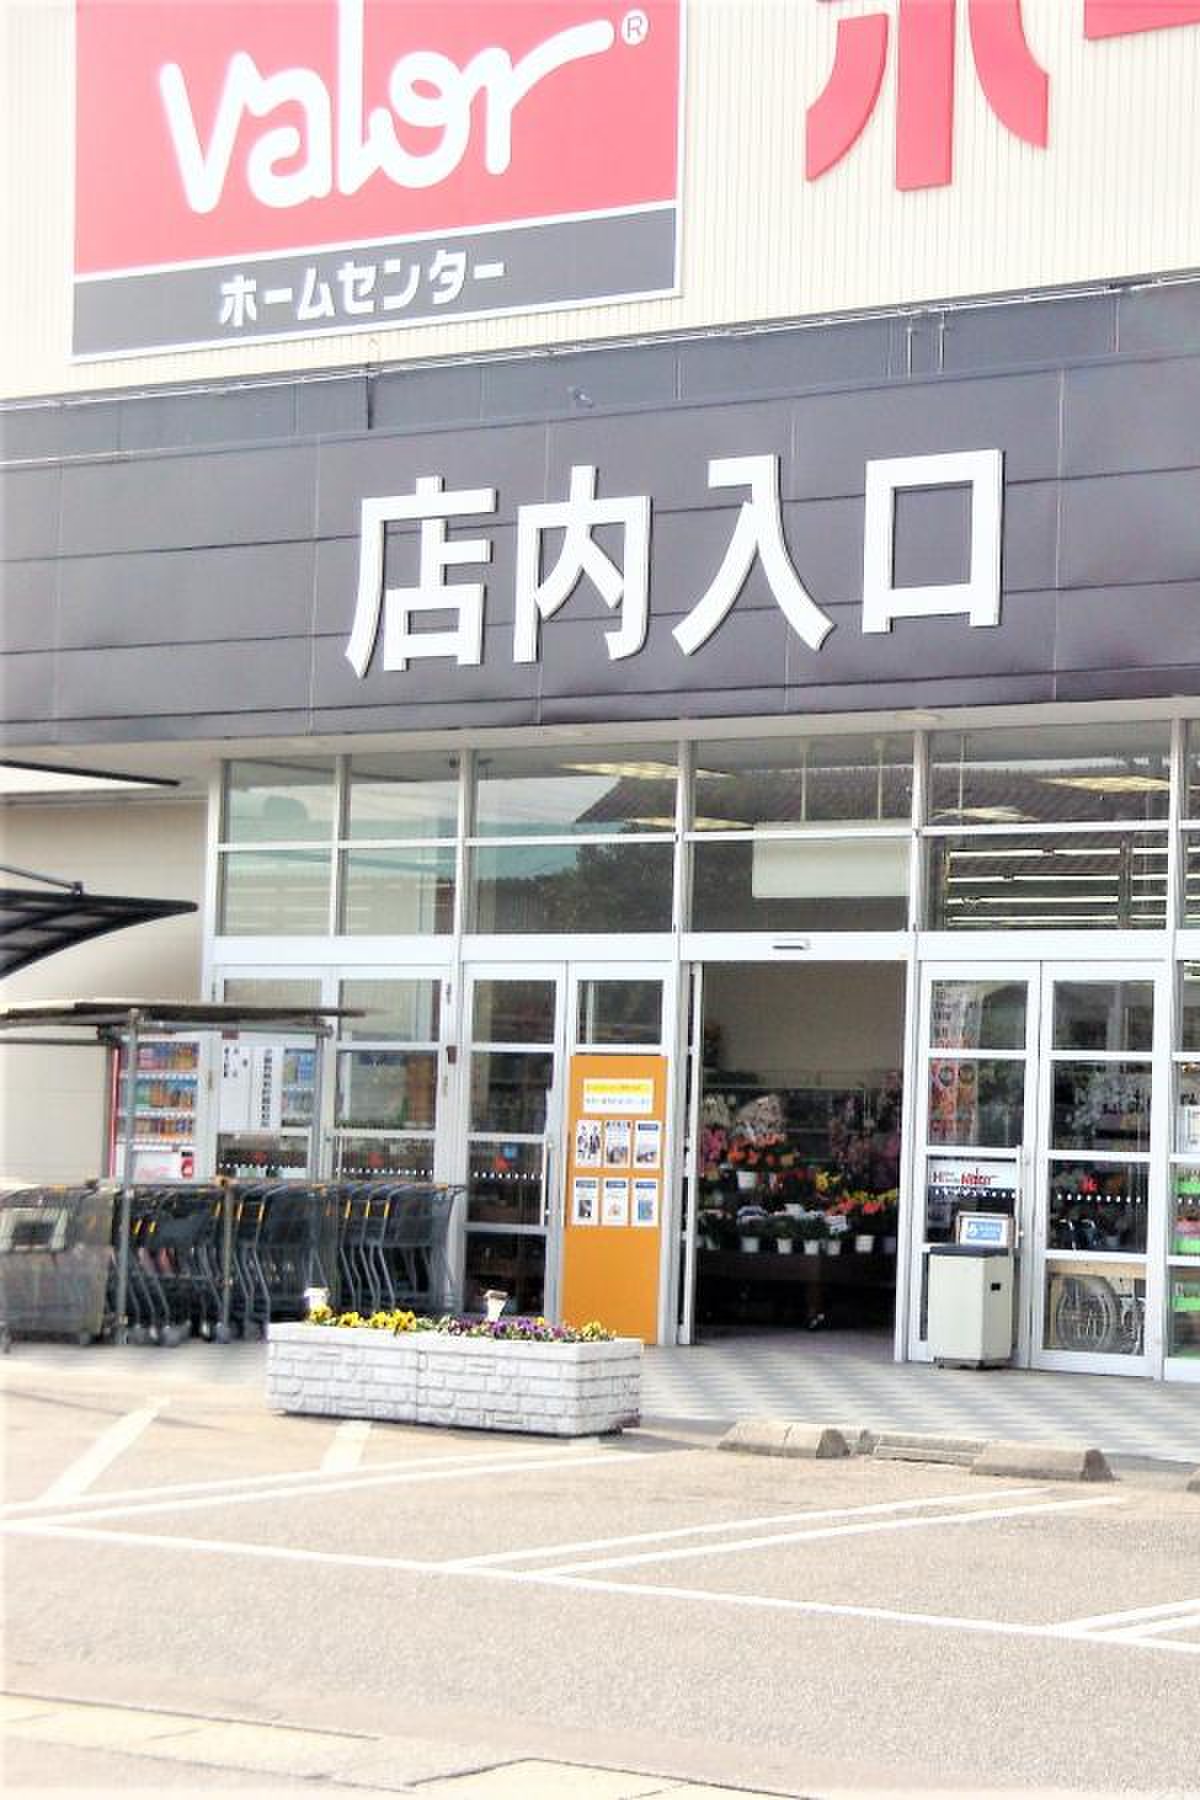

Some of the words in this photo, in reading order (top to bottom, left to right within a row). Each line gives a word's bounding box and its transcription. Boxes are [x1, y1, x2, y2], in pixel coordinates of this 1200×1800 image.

[219, 249, 505, 328] ホームセンター
[344, 449, 1004, 679] 店内入口
